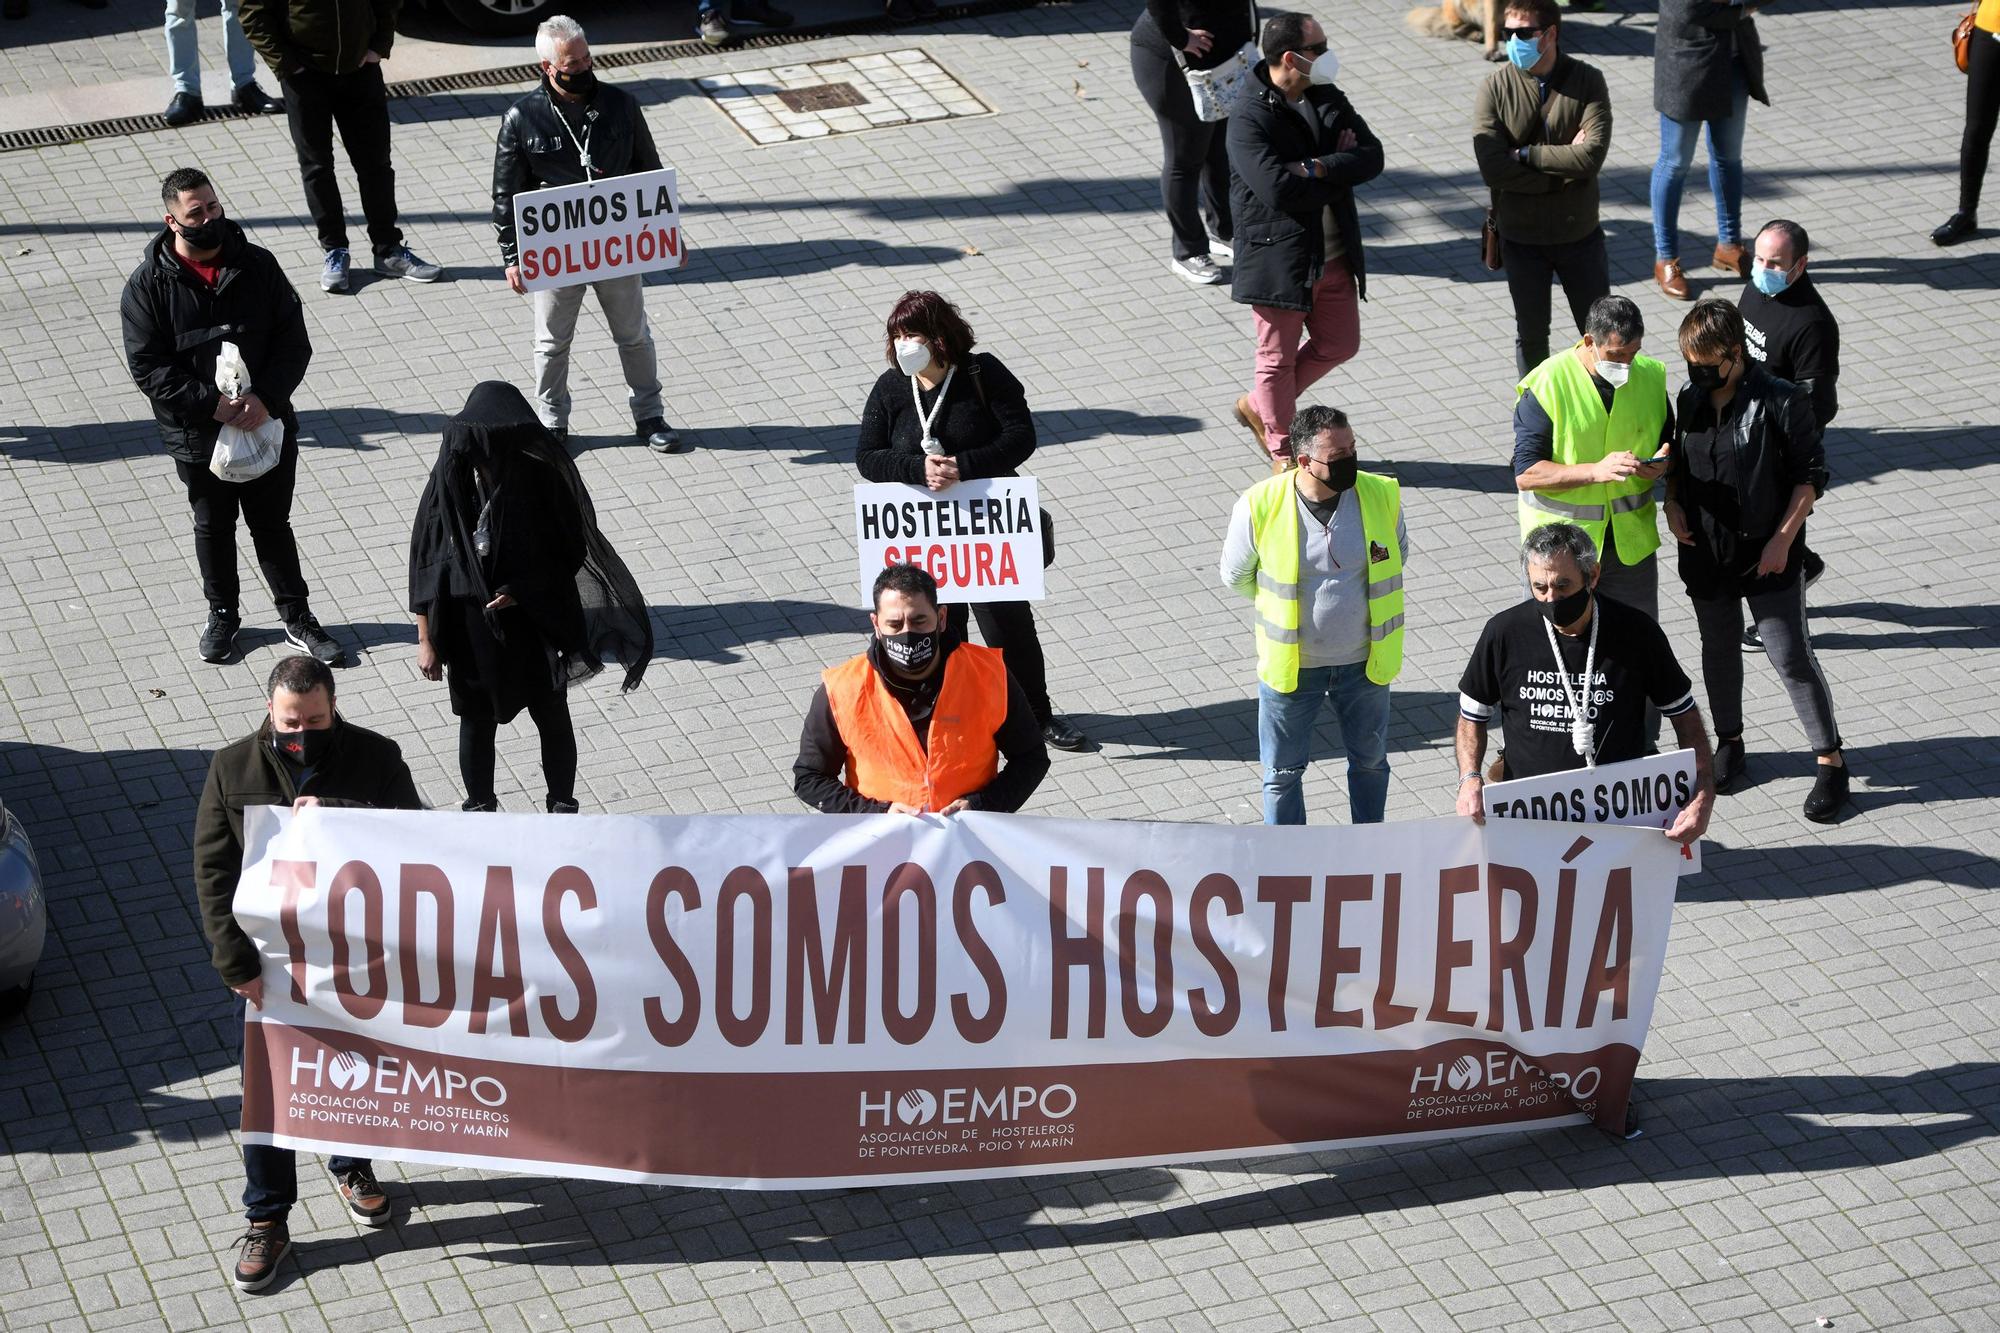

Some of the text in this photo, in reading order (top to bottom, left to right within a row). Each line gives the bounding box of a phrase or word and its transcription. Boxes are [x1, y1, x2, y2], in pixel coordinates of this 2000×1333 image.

[522, 185, 673, 236] SOMOS LA
[522, 224, 678, 280] SOLUCIÓN
[862, 489, 1034, 540] HOSTELERÍA
[1520, 686, 1565, 702] SOMOS
[1594, 770, 1690, 822] SOMOS
[268, 835, 1633, 1047] TODAS SOMOS HOSTELERÍA
[290, 1092, 509, 1123] ASOCIACIÓN DE HOSTELEROS
[1406, 1110, 1423, 1120] DE
[1519, 1093, 1548, 1108] POIO
[1552, 1091, 1560, 1101] Y
[1408, 1091, 1491, 1108] ASOCIACIÓN
[1504, 1086, 1519, 1098] DE
[289, 1108, 306, 1119] DE
[410, 1119, 445, 1132] POIO
[450, 1121, 459, 1133] Y
[463, 1123, 509, 1138] MARÍN
[859, 1124, 1075, 1144] ASOCIACIÓN DE HOSTELEROS
[859, 1147, 875, 1158] DE
[978, 1140, 1012, 1152] POIO
[1017, 1139, 1026, 1150] Y
[1029, 1136, 1073, 1149] MARÍN
